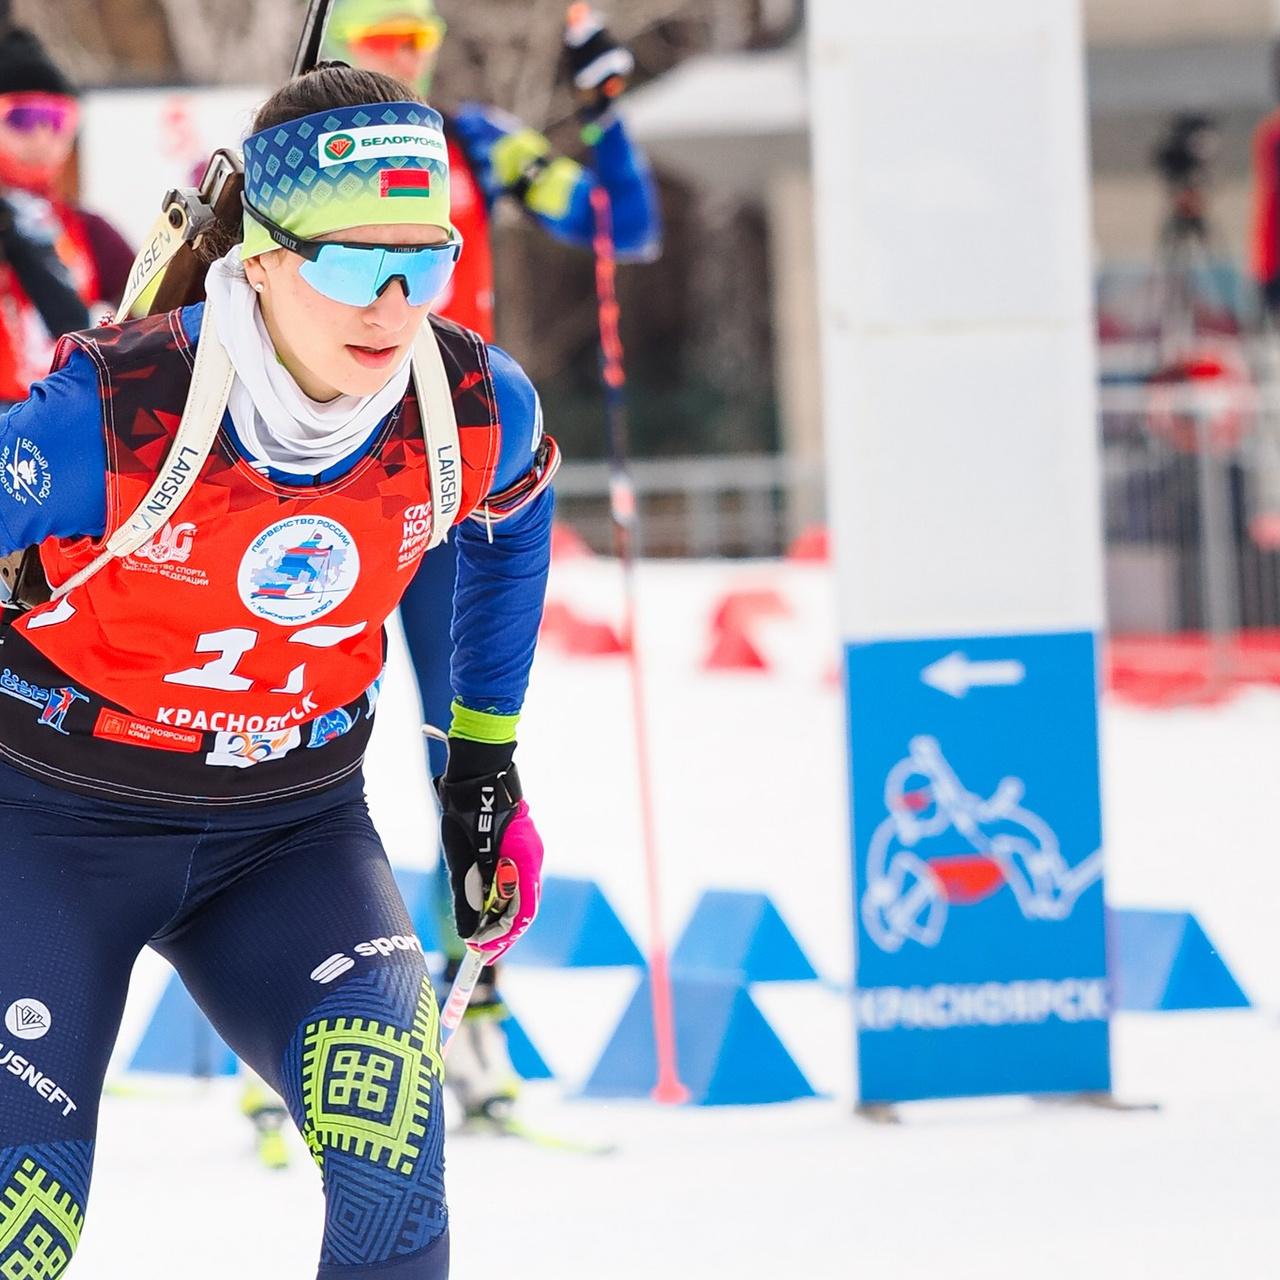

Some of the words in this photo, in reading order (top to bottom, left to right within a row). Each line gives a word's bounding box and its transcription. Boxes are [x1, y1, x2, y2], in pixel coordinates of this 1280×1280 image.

[21, 438, 49, 470] БЕЛЫЙ
[38, 471, 52, 499] ЛОСЬ
[146, 446, 199, 516] LARSEN
[437, 444, 457, 515] LARSEN
[251, 518, 315, 553] ПЕРВЕНСТВО
[316, 519, 351, 548] РОССИИ
[159, 569, 210, 587] ФЕДЕРАЦИИ
[175, 565, 207, 578] СПОРТА
[127, 729, 151, 742] КРАЙ
[129, 721, 197, 744] КРАСНОЯРСКИЙ
[477, 785, 495, 854] LEKI
